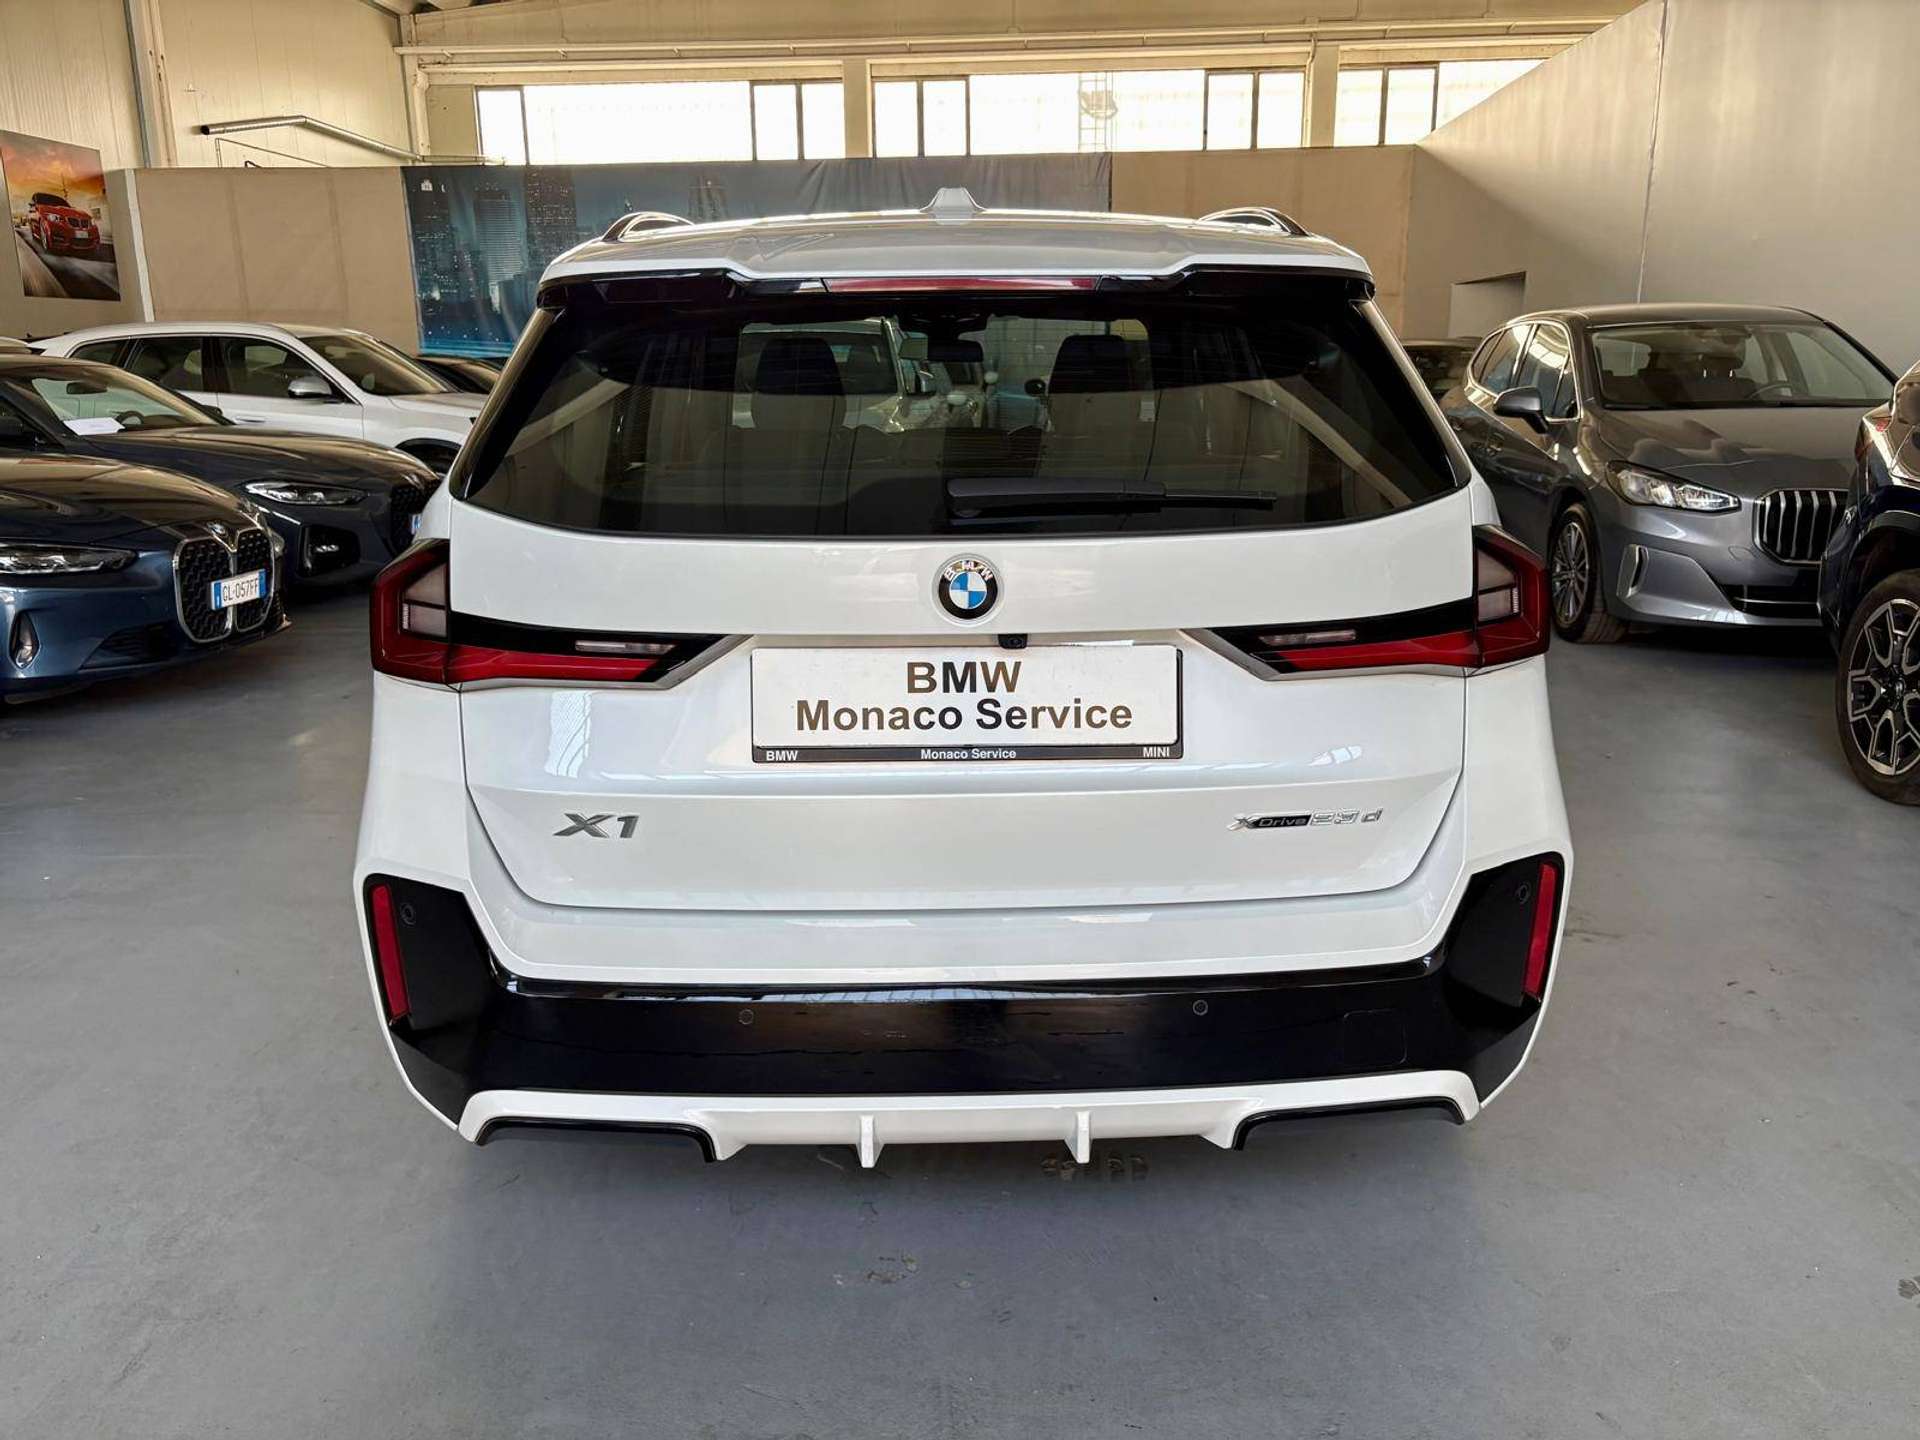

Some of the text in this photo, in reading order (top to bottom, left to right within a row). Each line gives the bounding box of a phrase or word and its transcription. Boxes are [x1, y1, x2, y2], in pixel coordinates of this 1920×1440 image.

[944, 561, 994, 581] BMW
[907, 661, 1022, 693] BMW
[797, 698, 1132, 731] Monaco Service
[766, 751, 798, 761] BMW
[921, 748, 1017, 760] Monaco Service
[1143, 747, 1170, 757] MINI
[552, 813, 640, 838] X1
